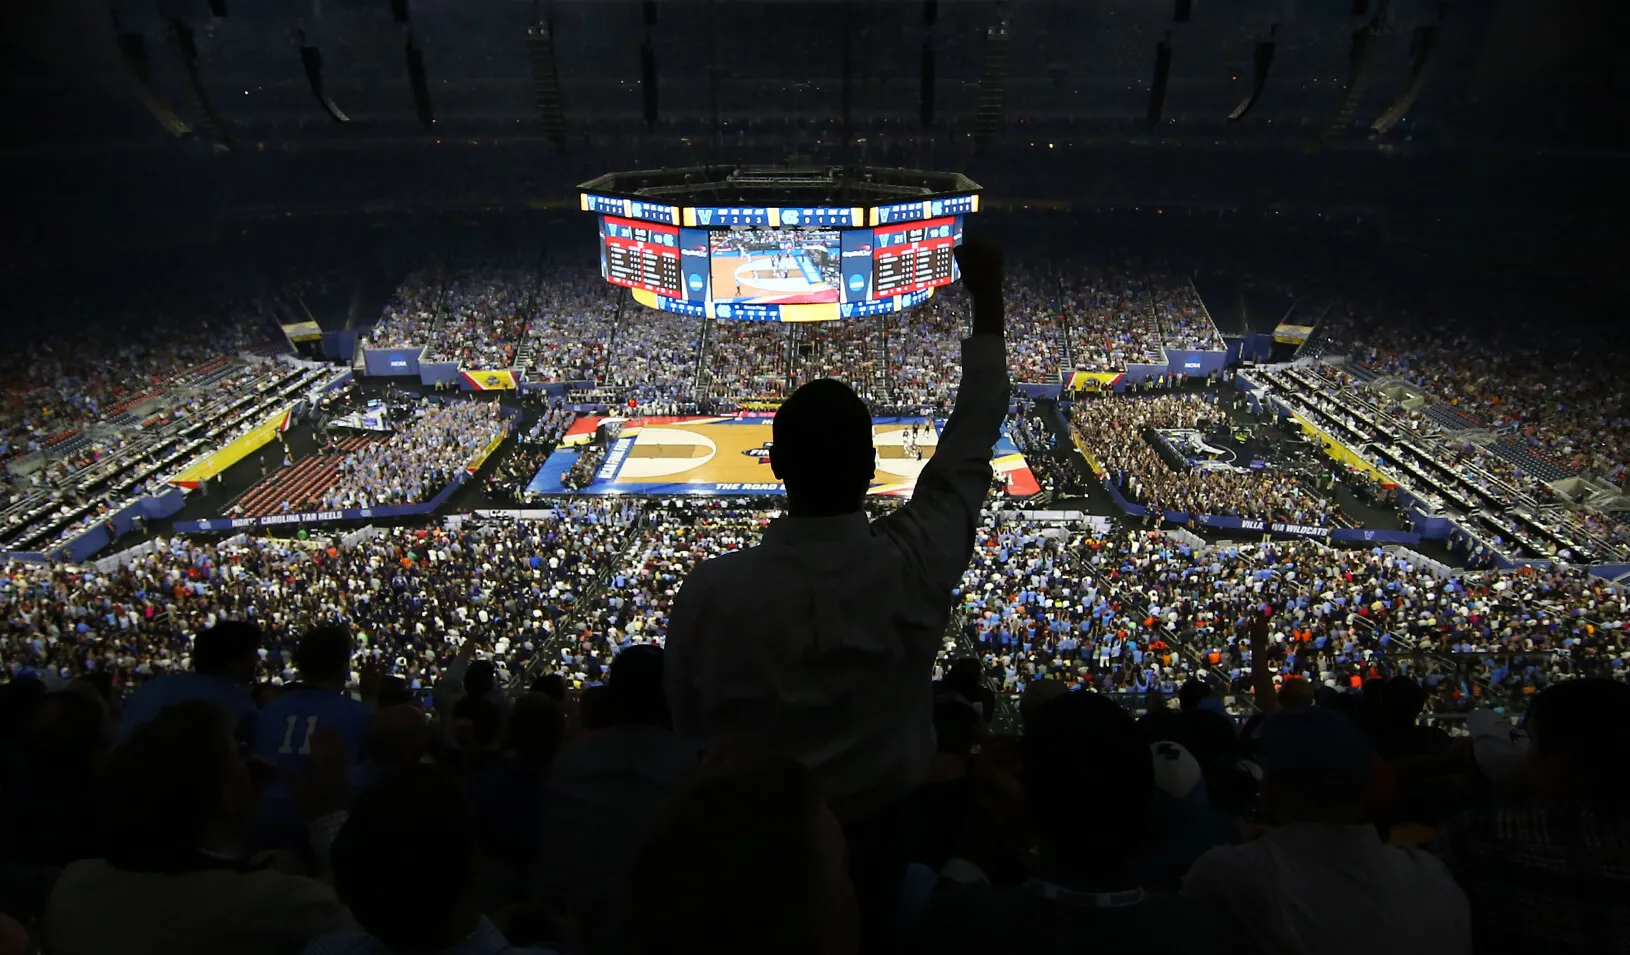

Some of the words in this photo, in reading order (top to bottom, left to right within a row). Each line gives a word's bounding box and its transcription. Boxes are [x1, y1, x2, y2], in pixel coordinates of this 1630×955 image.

[260, 513, 300, 525] CAROLINA
[301, 512, 318, 522] TAR
[318, 510, 343, 521] HEELS
[1285, 523, 1329, 537] WILDCATS
[277, 714, 319, 755] 11
